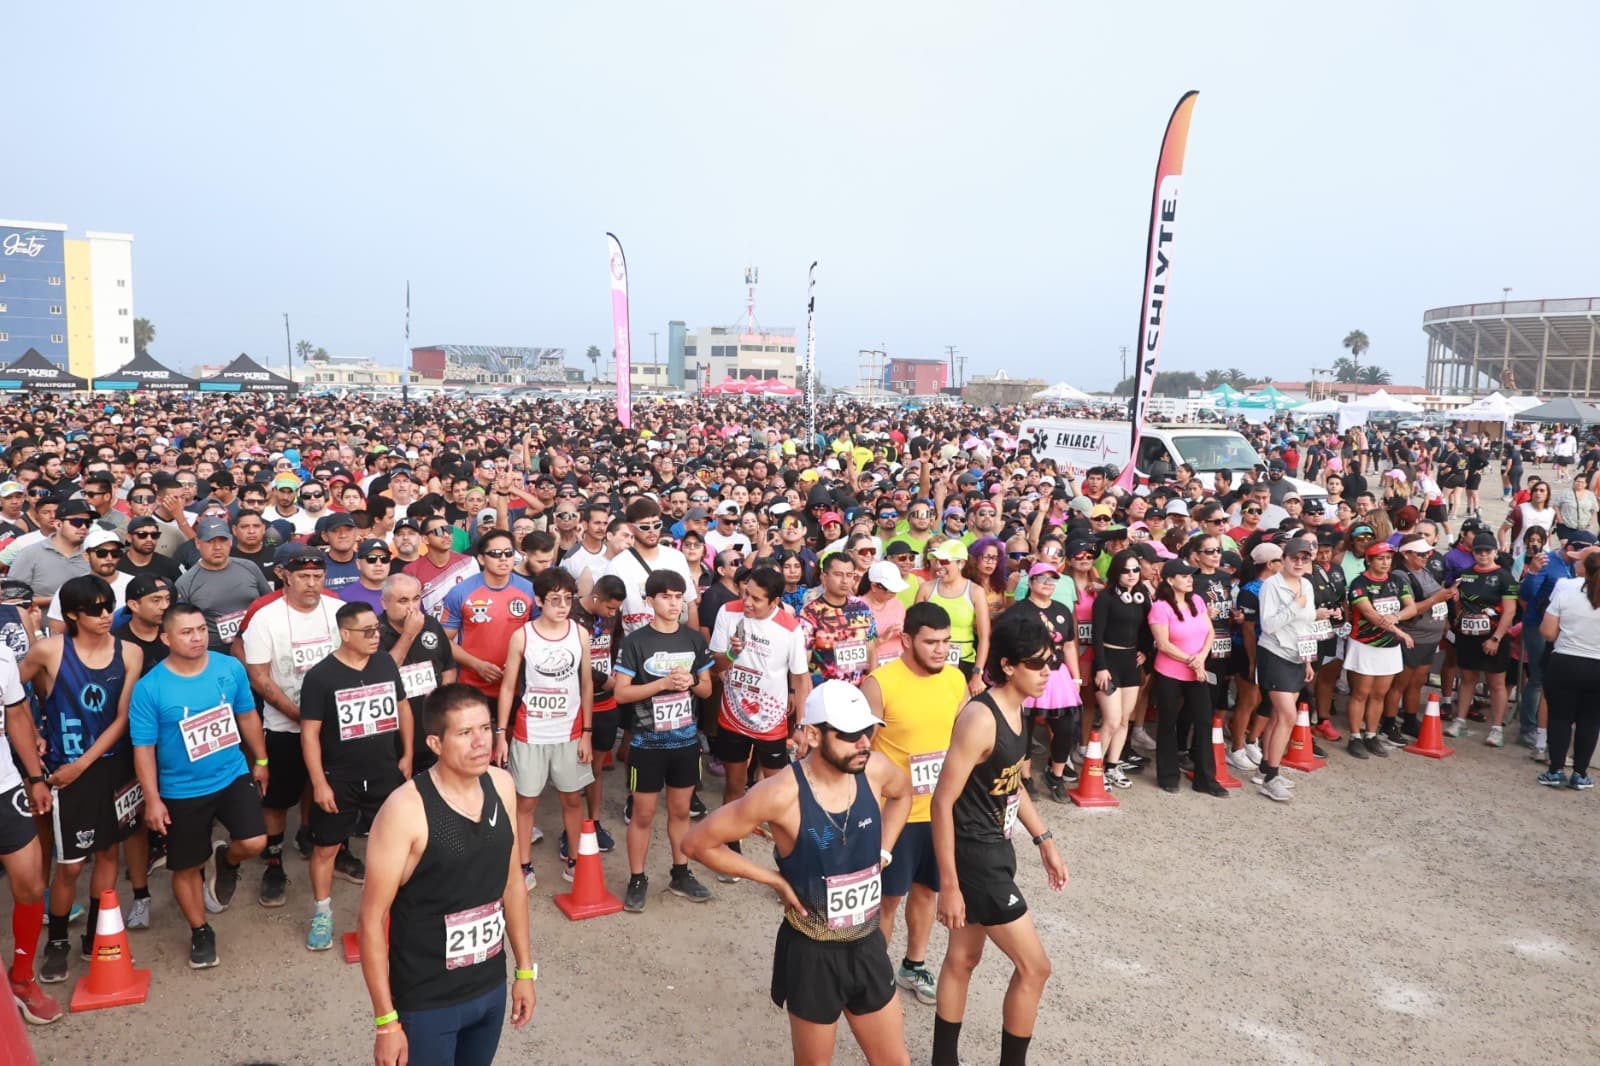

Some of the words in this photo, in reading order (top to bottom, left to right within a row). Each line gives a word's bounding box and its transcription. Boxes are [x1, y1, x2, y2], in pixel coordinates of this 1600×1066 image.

[1056, 432, 1097, 449] ENLACE
[1079, 626, 1091, 637] 01
[1462, 619, 1489, 630] 5010
[295, 644, 332, 664] 3047
[837, 647, 866, 662] 4353
[402, 669, 433, 688] 184
[732, 670, 762, 686] 1837
[340, 695, 395, 725] 3750
[528, 695, 568, 710] 4002
[655, 699, 691, 721] 5724
[187, 716, 232, 746] 1787
[913, 762, 942, 782] 119
[117, 785, 143, 815] 1422
[829, 879, 880, 913] 5672
[448, 915, 502, 953] 2151
